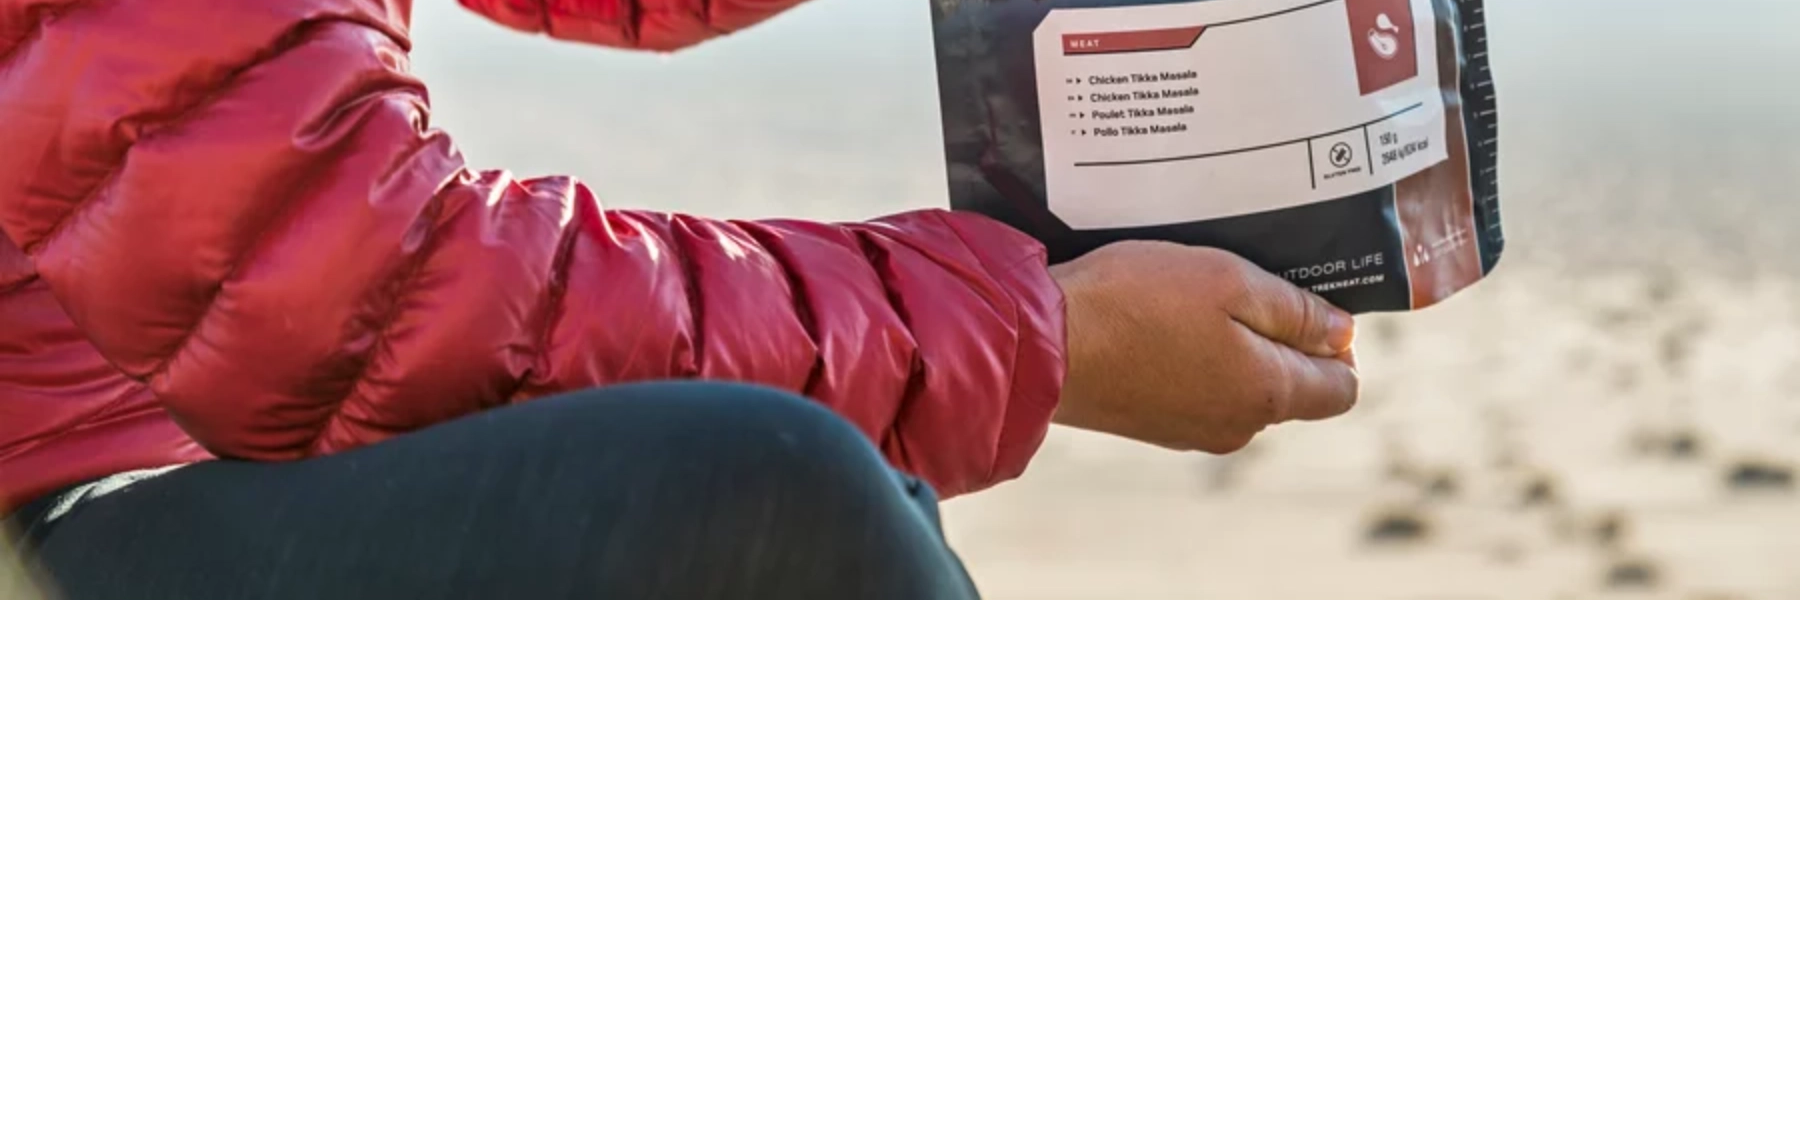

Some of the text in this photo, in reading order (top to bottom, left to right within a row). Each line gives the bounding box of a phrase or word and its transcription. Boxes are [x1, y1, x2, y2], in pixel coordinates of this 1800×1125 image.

[1069, 38, 1100, 48] MEAT
[1088, 69, 1197, 85] Chicken Tikka Masala
[1089, 86, 1199, 103] Chicken Tikka Masala
[1091, 104, 1195, 120] Poulet Tikka Masala
[1093, 122, 1187, 137] Pollo Tikka Masala
[1351, 252, 1384, 269] LIFE
